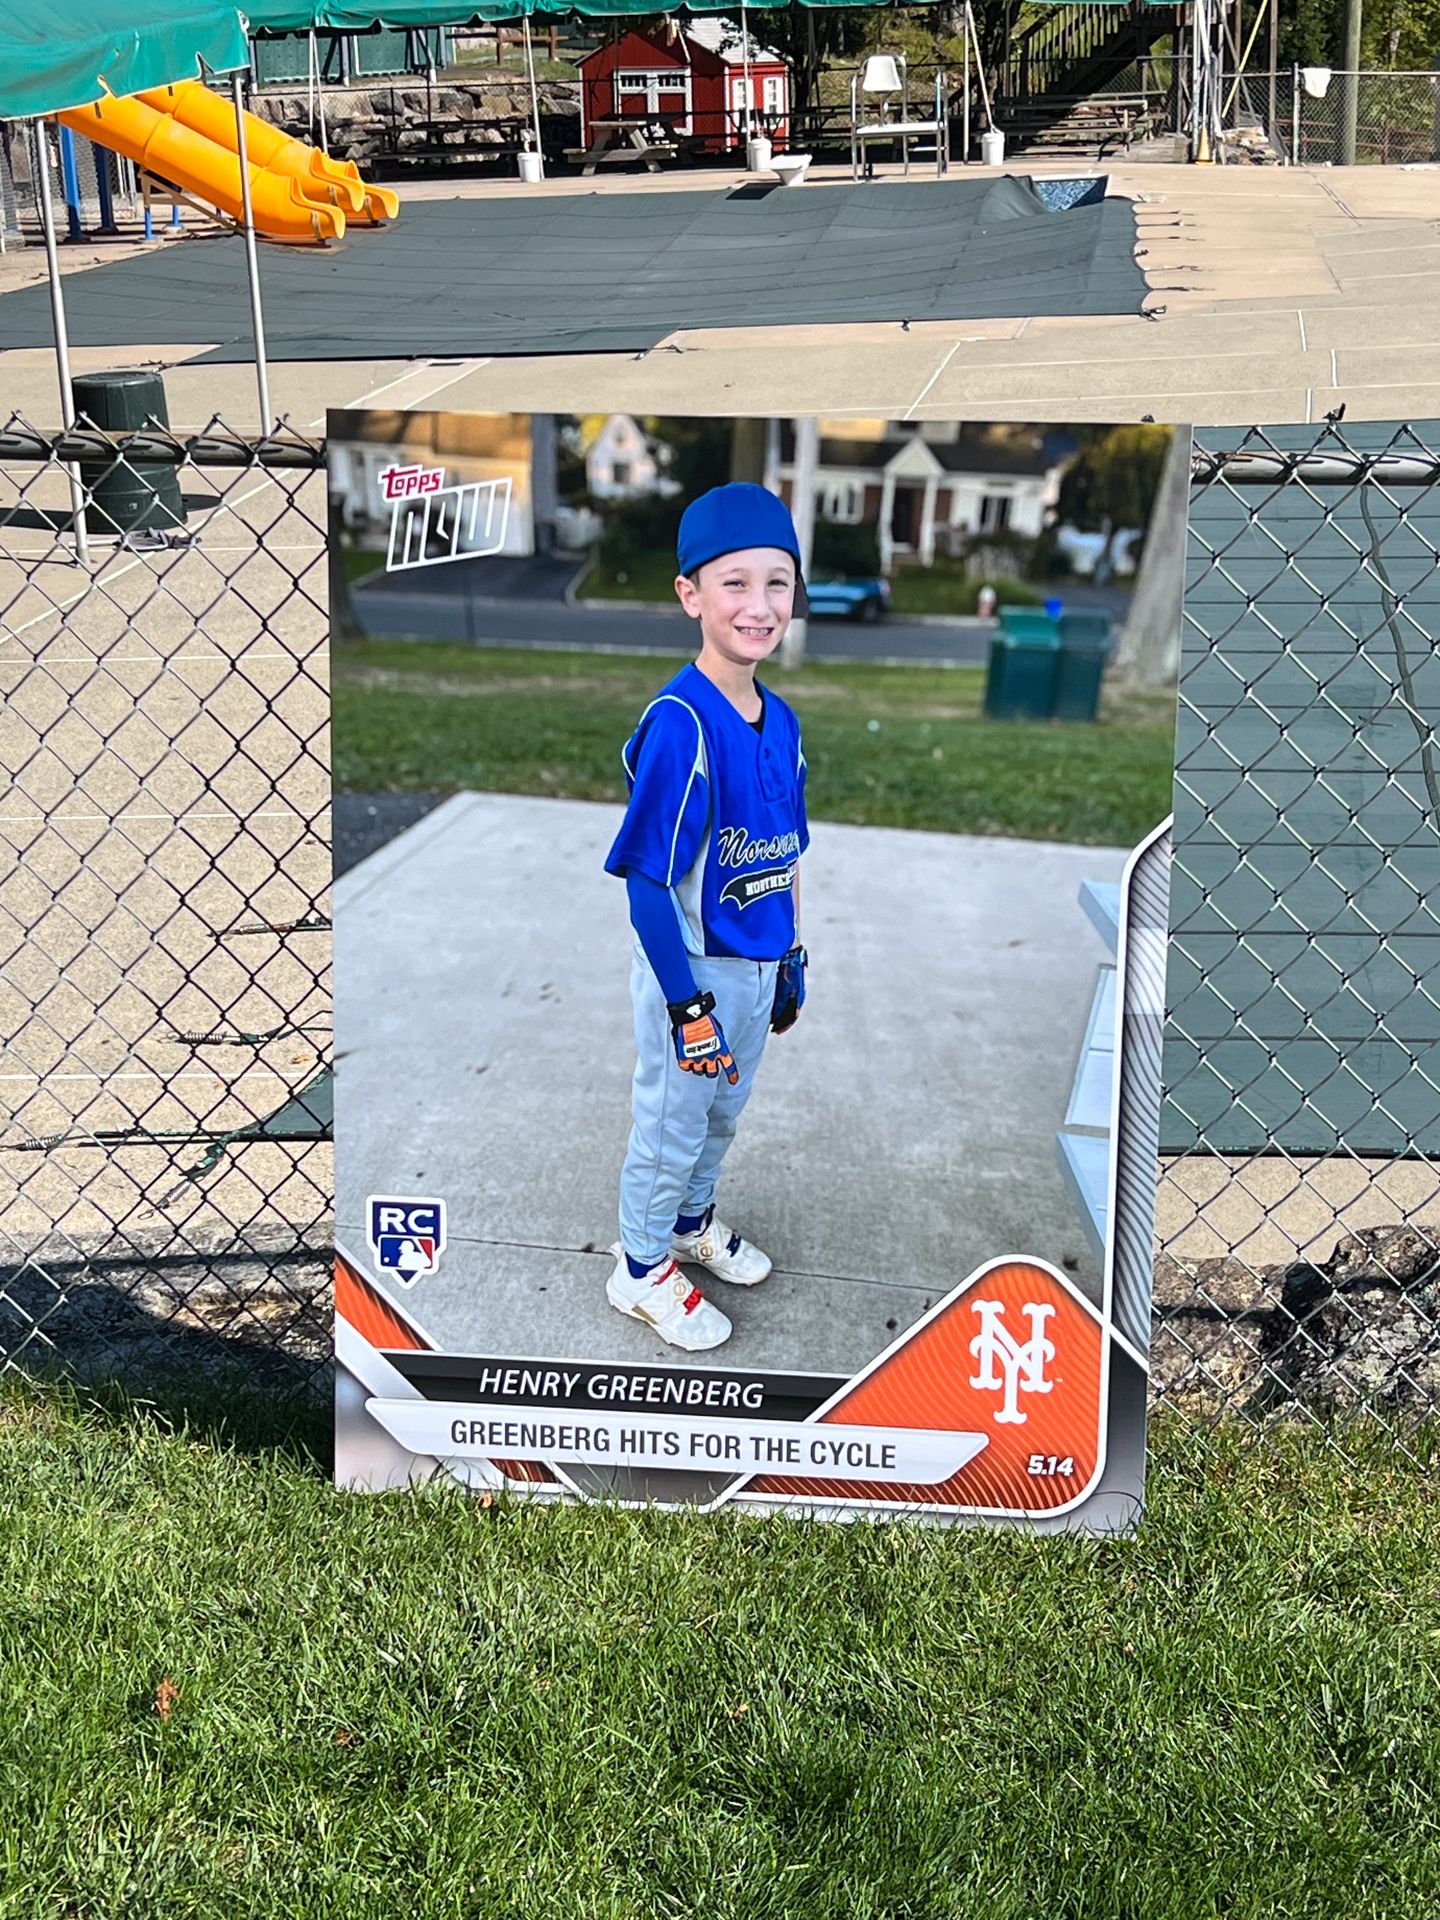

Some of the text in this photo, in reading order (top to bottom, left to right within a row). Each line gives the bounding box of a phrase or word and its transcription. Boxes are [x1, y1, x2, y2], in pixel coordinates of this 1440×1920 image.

[380, 1207, 434, 1234] RC
[479, 1367, 765, 1409] HENRY GREENBERG
[450, 1420, 897, 1469] GREENBERG HITS FOR THE CYCLE
[1027, 1454, 1074, 1477] 5.14
